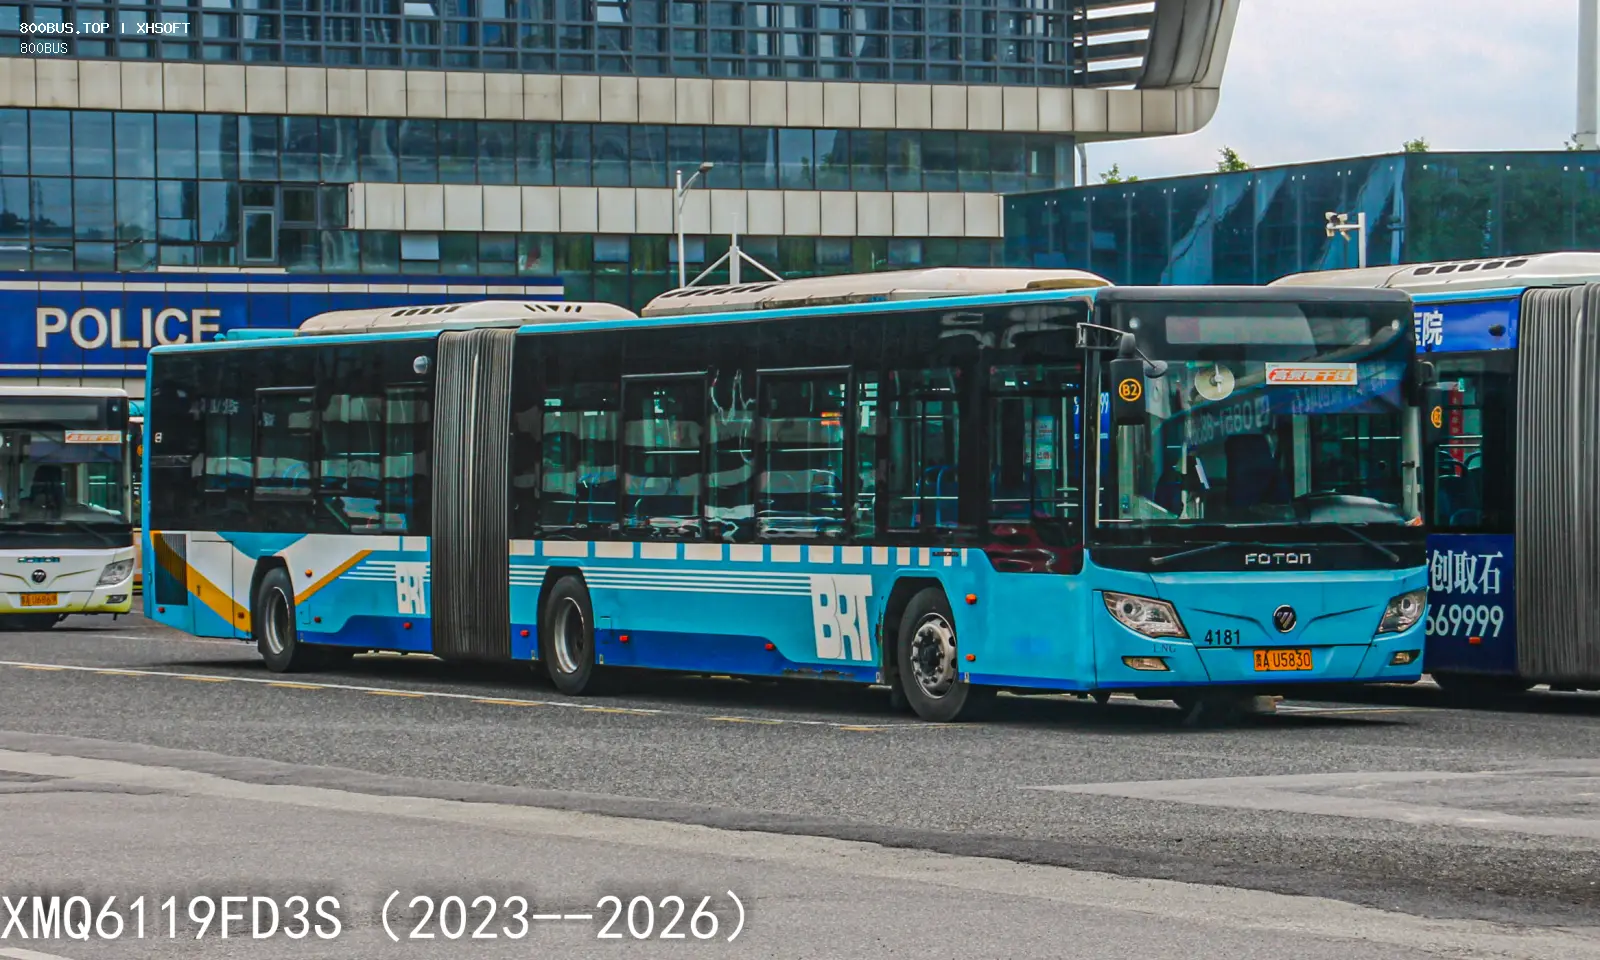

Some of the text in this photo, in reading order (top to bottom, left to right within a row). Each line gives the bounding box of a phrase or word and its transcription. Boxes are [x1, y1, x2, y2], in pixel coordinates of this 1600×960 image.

[36, 307, 221, 349] POLICE
[1122, 384, 1137, 396] B2
[1245, 553, 1311, 565] FOTON
[1426, 549, 1504, 595] 创取石
[395, 562, 427, 614] BRT
[811, 574, 873, 661] BRT
[1153, 644, 1176, 653] LNG
[1204, 629, 1240, 645] 4181
